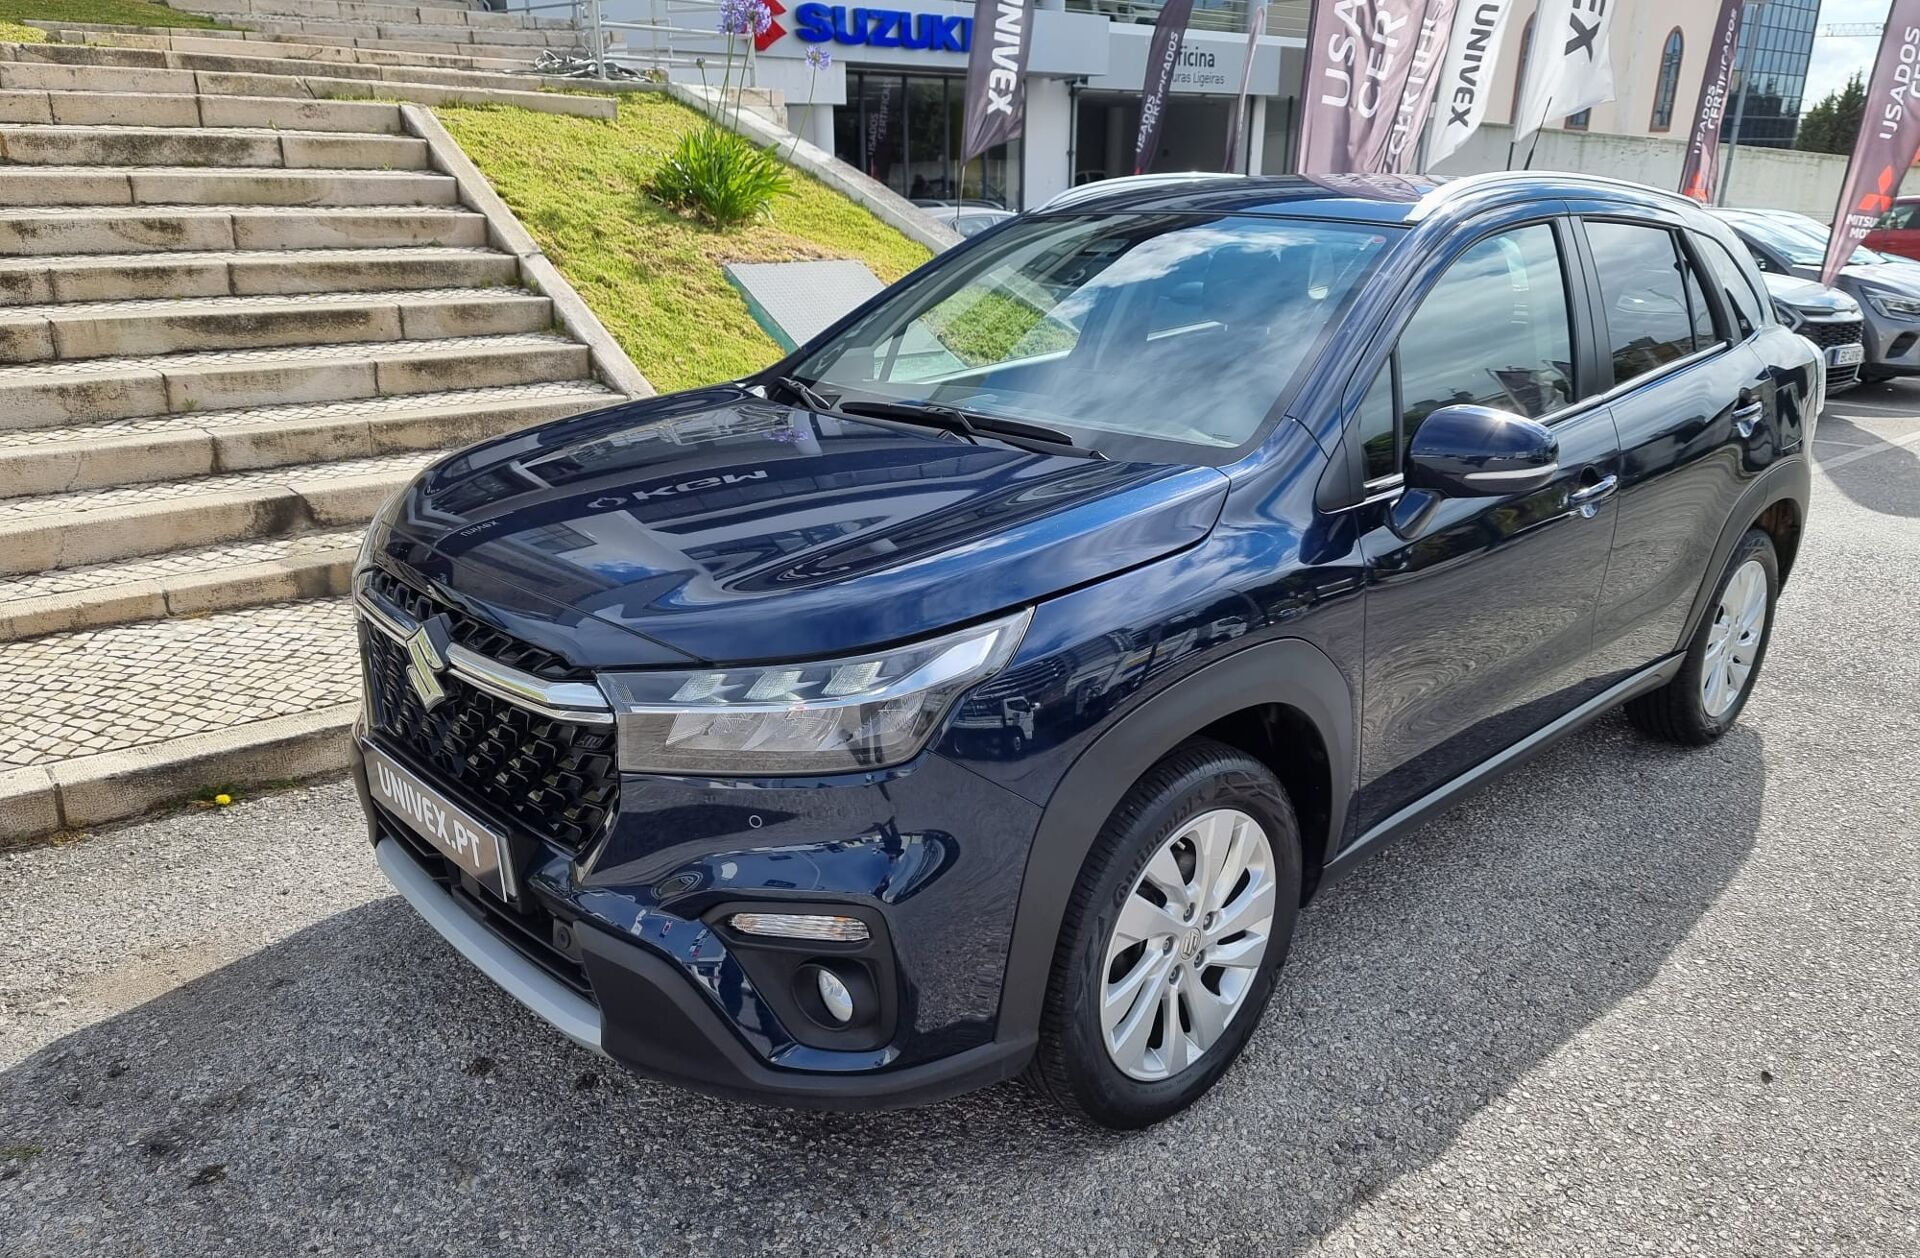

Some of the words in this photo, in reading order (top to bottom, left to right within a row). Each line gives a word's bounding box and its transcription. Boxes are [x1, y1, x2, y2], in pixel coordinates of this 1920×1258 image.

[794, 2, 974, 53] SUZUKI
[987, 0, 1024, 116] NIVEX
[1177, 46, 1216, 68] ficina
[1193, 71, 1225, 87] Ligeiras
[1448, 3, 1500, 128] UNIVEX
[1879, 26, 1920, 140] USADOS
[1136, 94, 1155, 153] USADOS
[1694, 84, 1716, 154] USADOS
[376, 761, 480, 868] UNIVEX.PT
